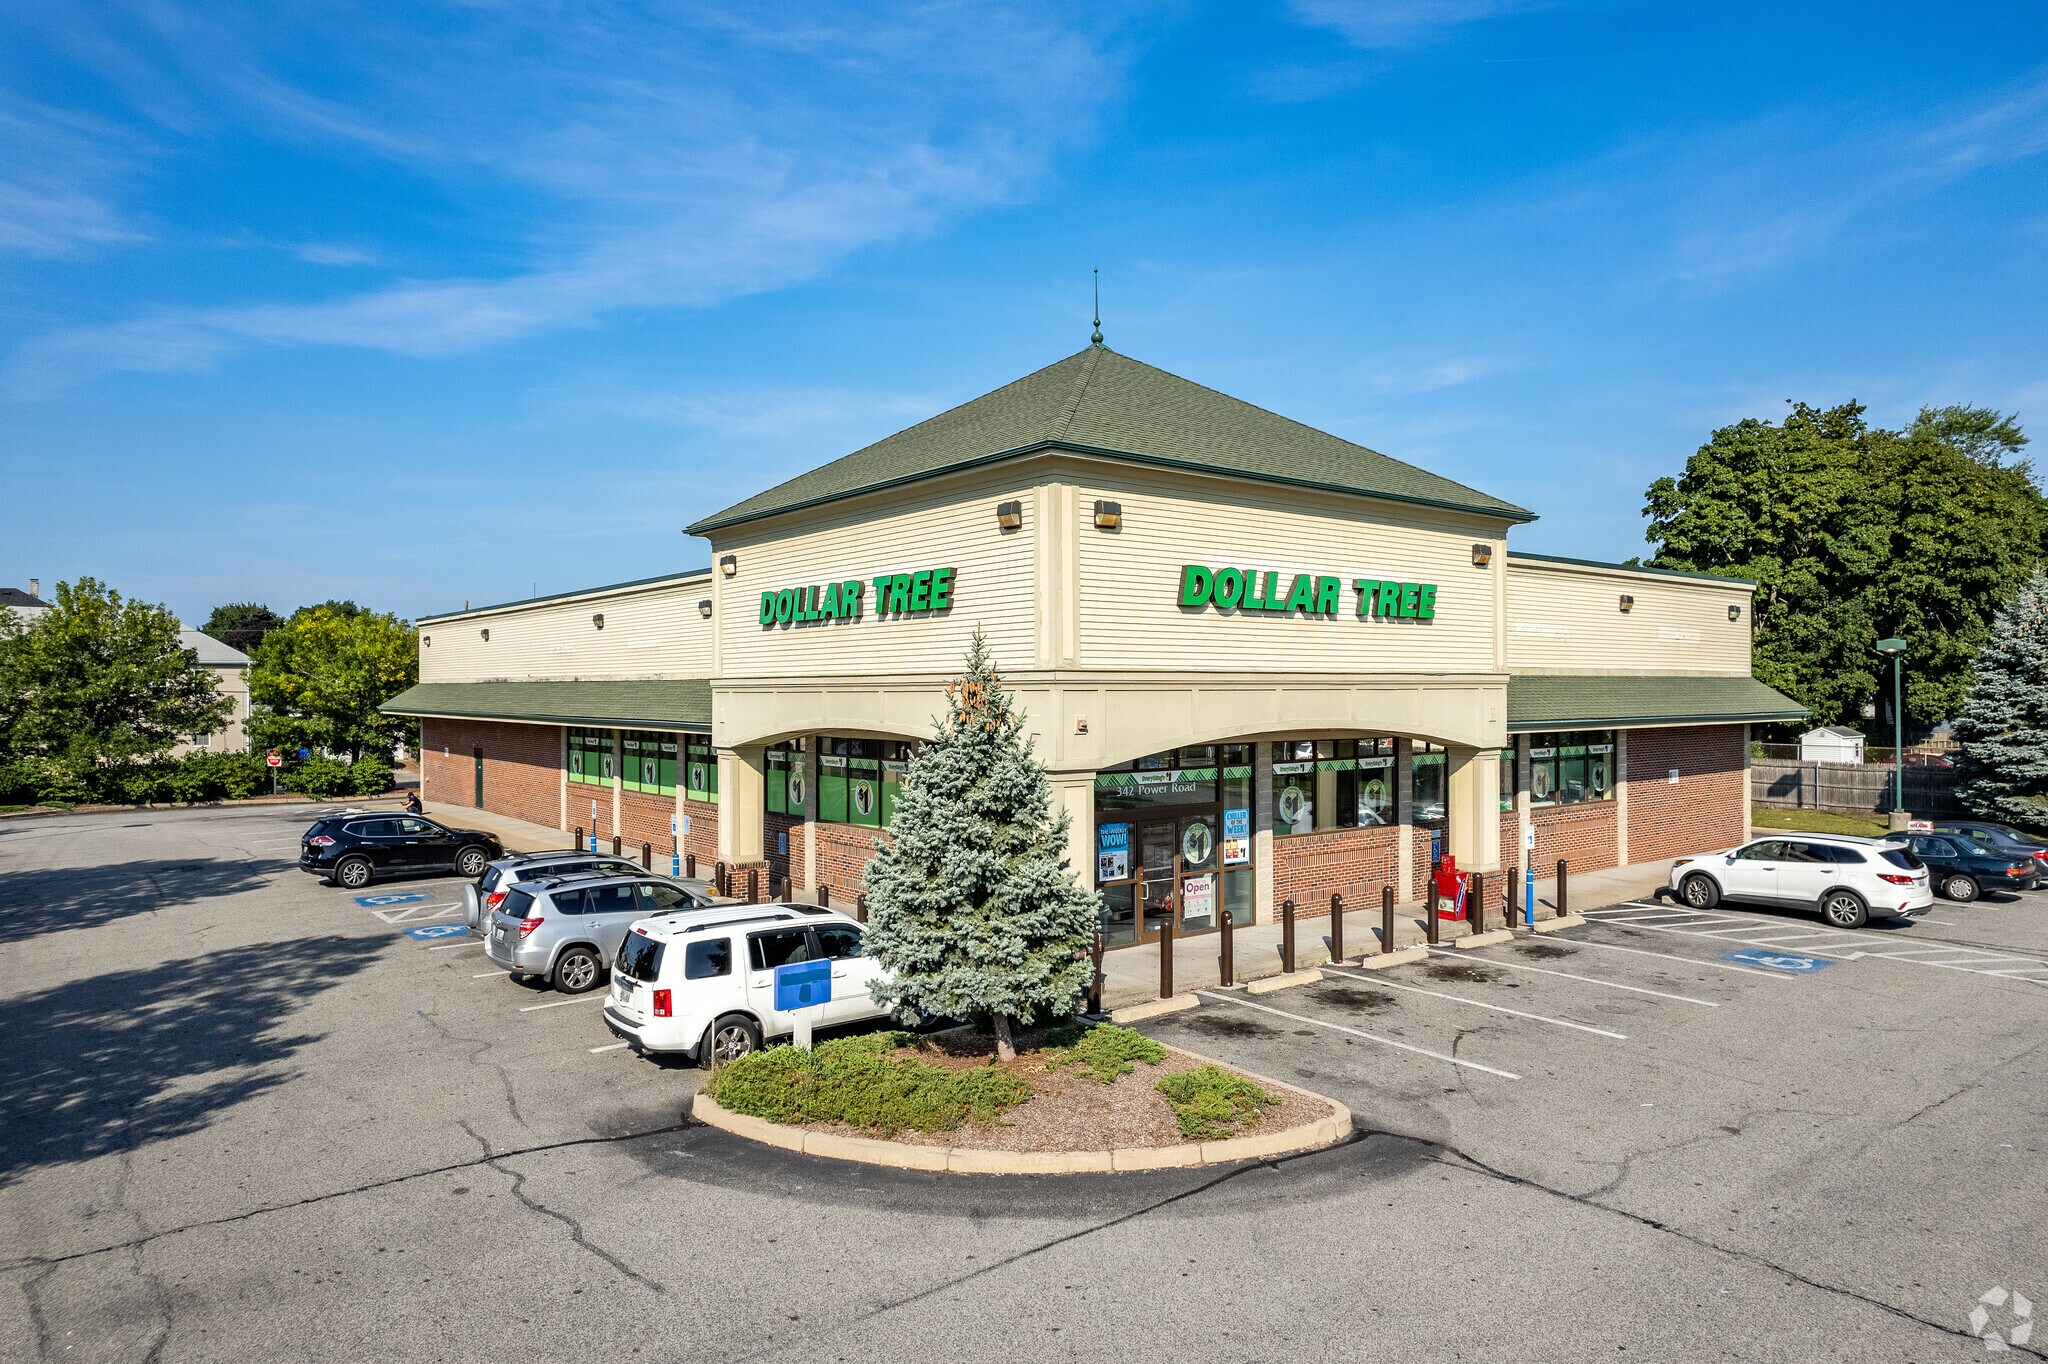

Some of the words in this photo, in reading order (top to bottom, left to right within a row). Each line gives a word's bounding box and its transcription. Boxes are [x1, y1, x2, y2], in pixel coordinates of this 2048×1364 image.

[759, 580, 864, 625] DOLLAR
[872, 567, 955, 615] TREE
[1178, 565, 1341, 611] DOLLAR
[1353, 579, 1438, 619] TREE
[1116, 785, 1134, 797] 342
[1138, 785, 1168, 796] Power
[1171, 782, 1196, 793] Road
[1227, 824, 1247, 834] WEEK!
[1101, 833, 1127, 847] WOW!
[1186, 883, 1210, 895] Open
